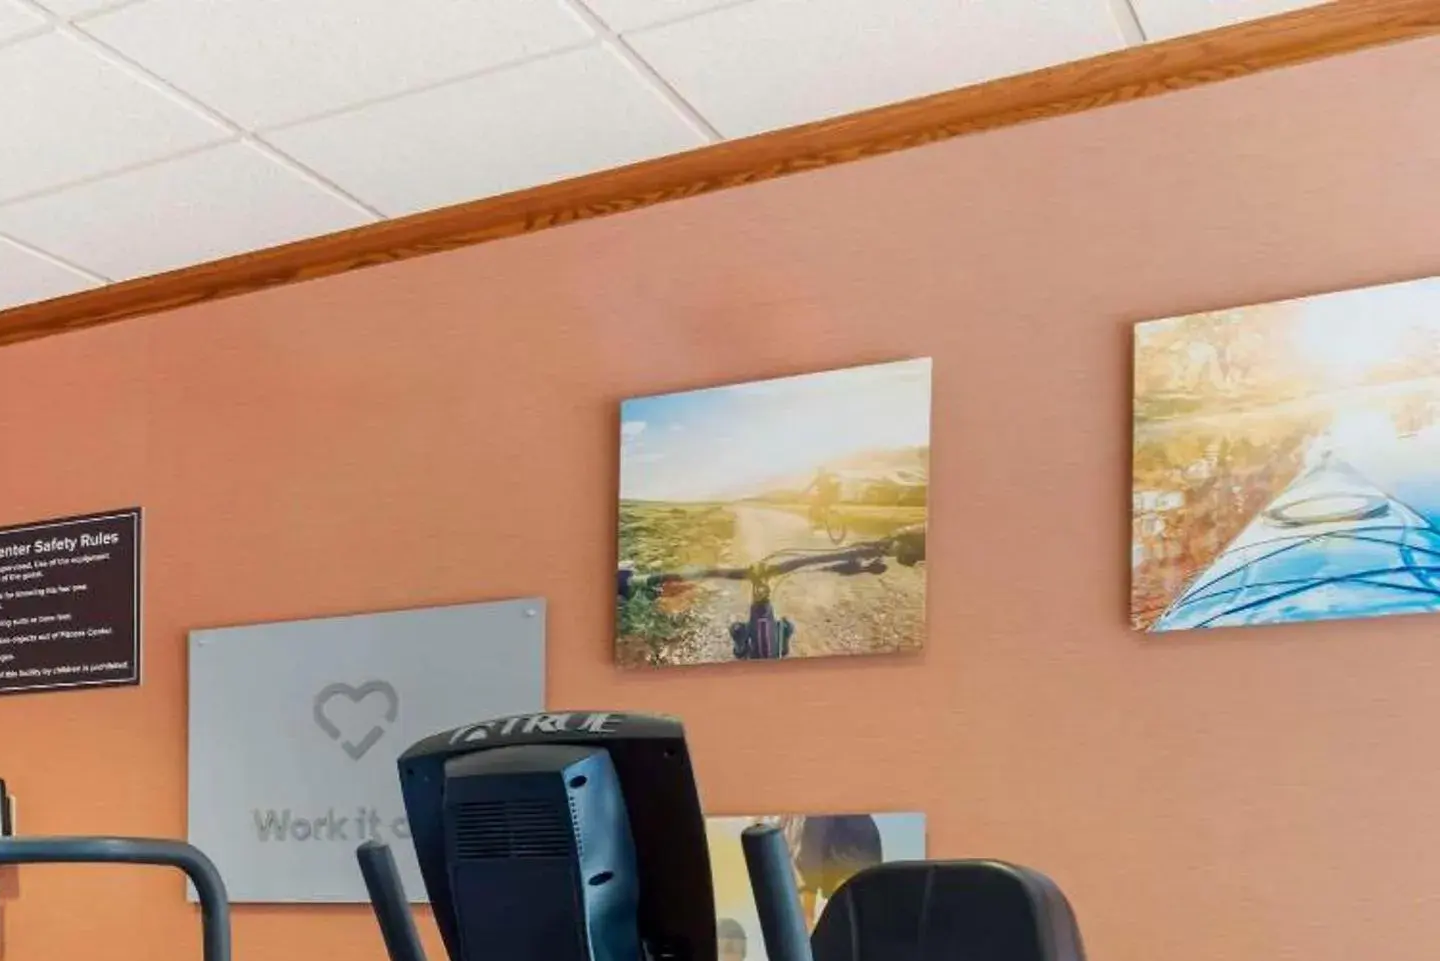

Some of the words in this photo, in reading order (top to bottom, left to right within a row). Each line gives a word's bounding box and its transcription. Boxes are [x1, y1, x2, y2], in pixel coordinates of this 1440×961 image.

[34, 537, 78, 553] Safety
[80, 532, 119, 548] Rules
[498, 712, 623, 737] TRUE
[251, 807, 349, 843] Work
[353, 806, 382, 843] it
